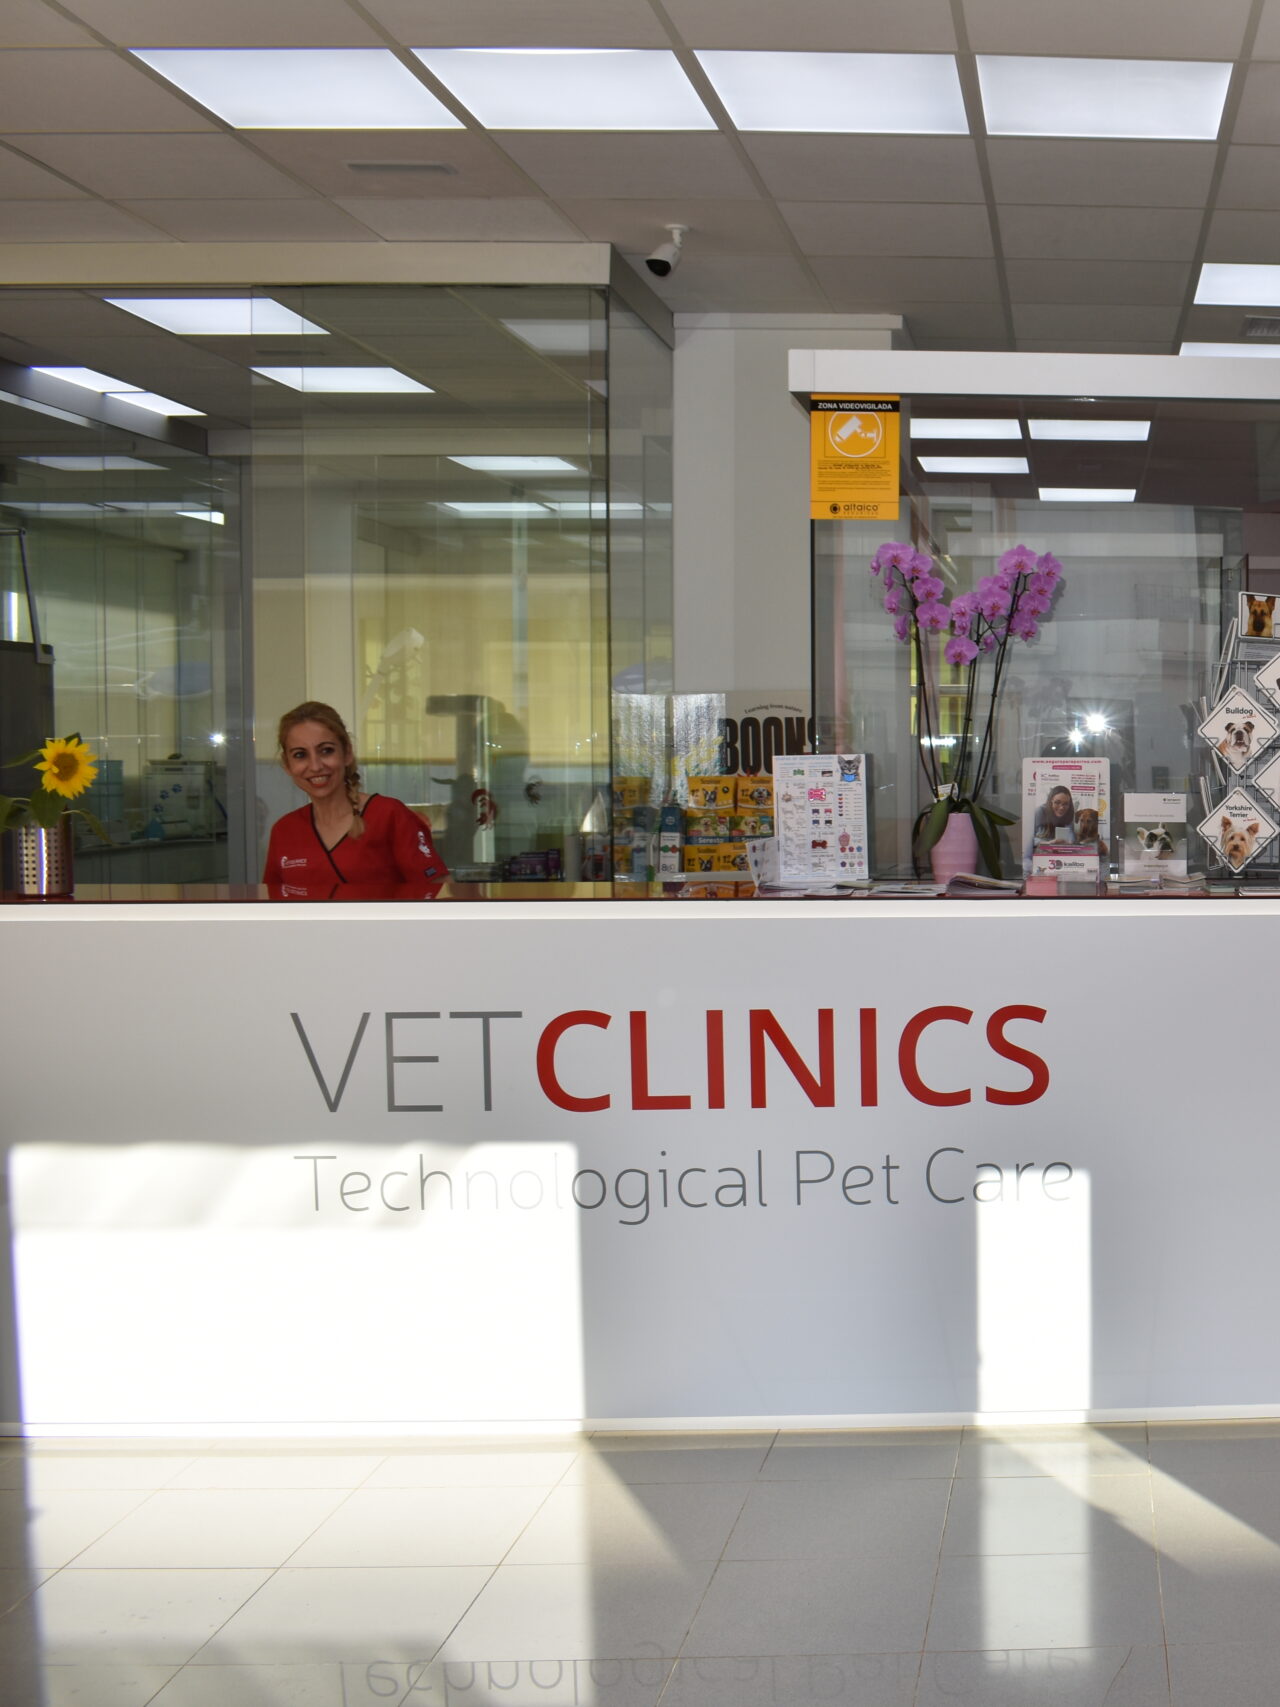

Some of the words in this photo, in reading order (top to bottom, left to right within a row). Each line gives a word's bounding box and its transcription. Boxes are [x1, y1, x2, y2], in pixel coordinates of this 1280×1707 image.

[839, 402, 893, 410] VIDEOVIGILADA
[1225, 707, 1254, 715] Bulldog
[293, 1149, 767, 1225] Technological
[795, 1149, 900, 1206] Pet
[925, 1146, 1073, 1204] Care
